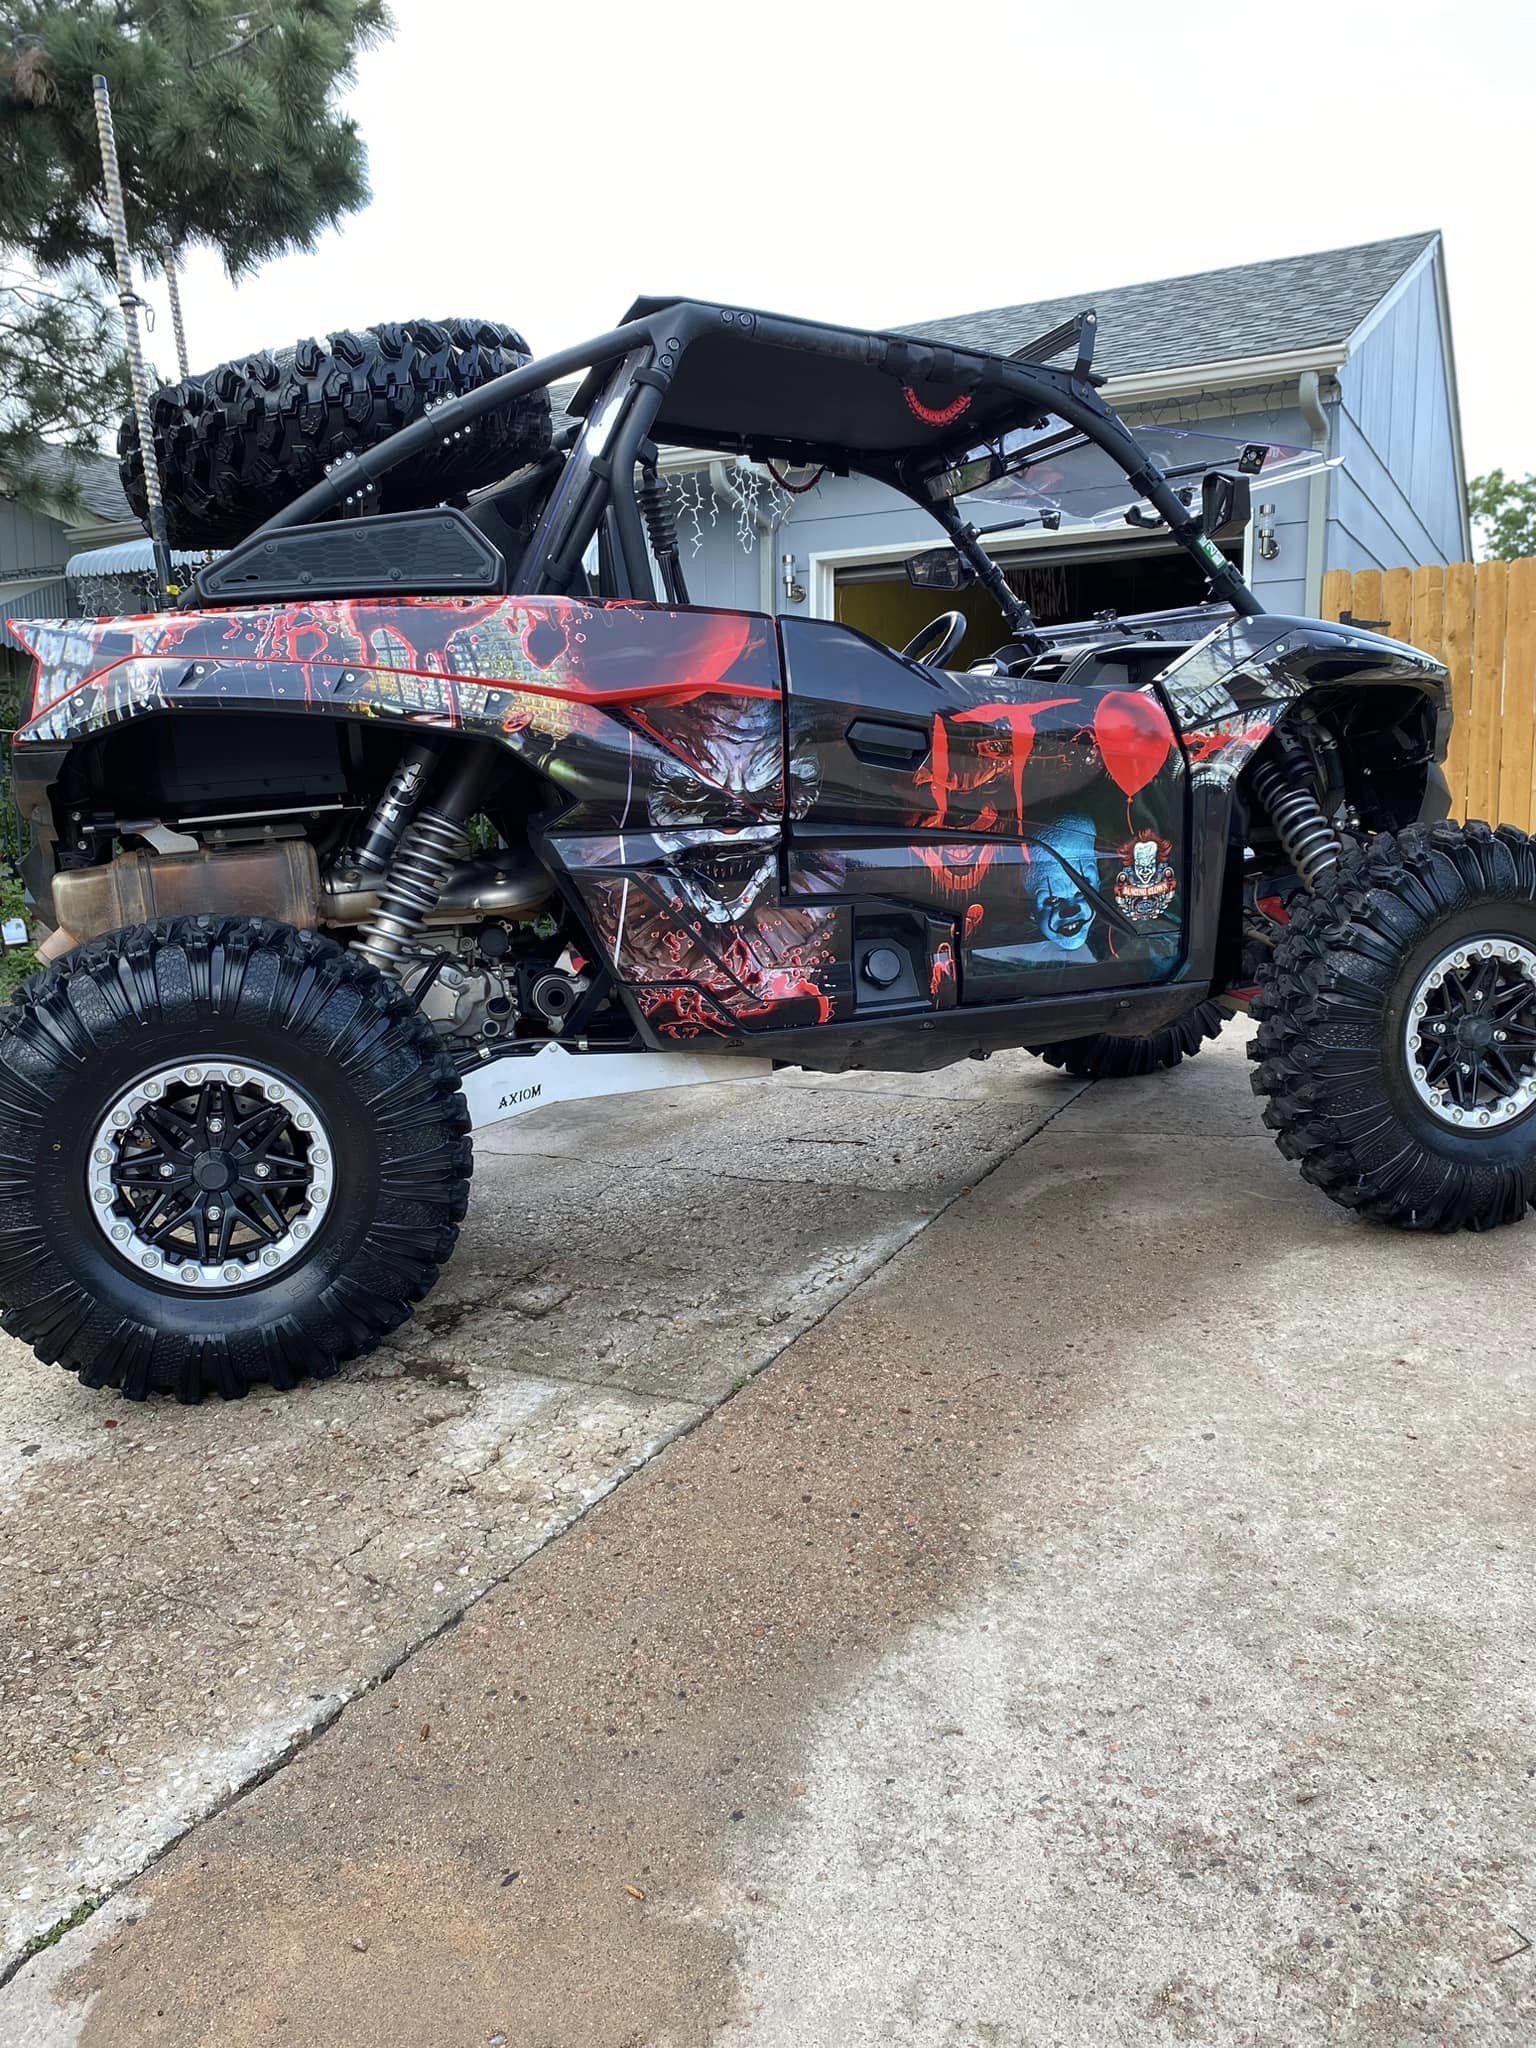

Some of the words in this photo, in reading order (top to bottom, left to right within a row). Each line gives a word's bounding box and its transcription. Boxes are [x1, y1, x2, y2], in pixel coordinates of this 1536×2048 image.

[373, 759, 427, 822] FOX
[931, 698, 1083, 864] IT
[498, 1084, 542, 1110] AXIOM
